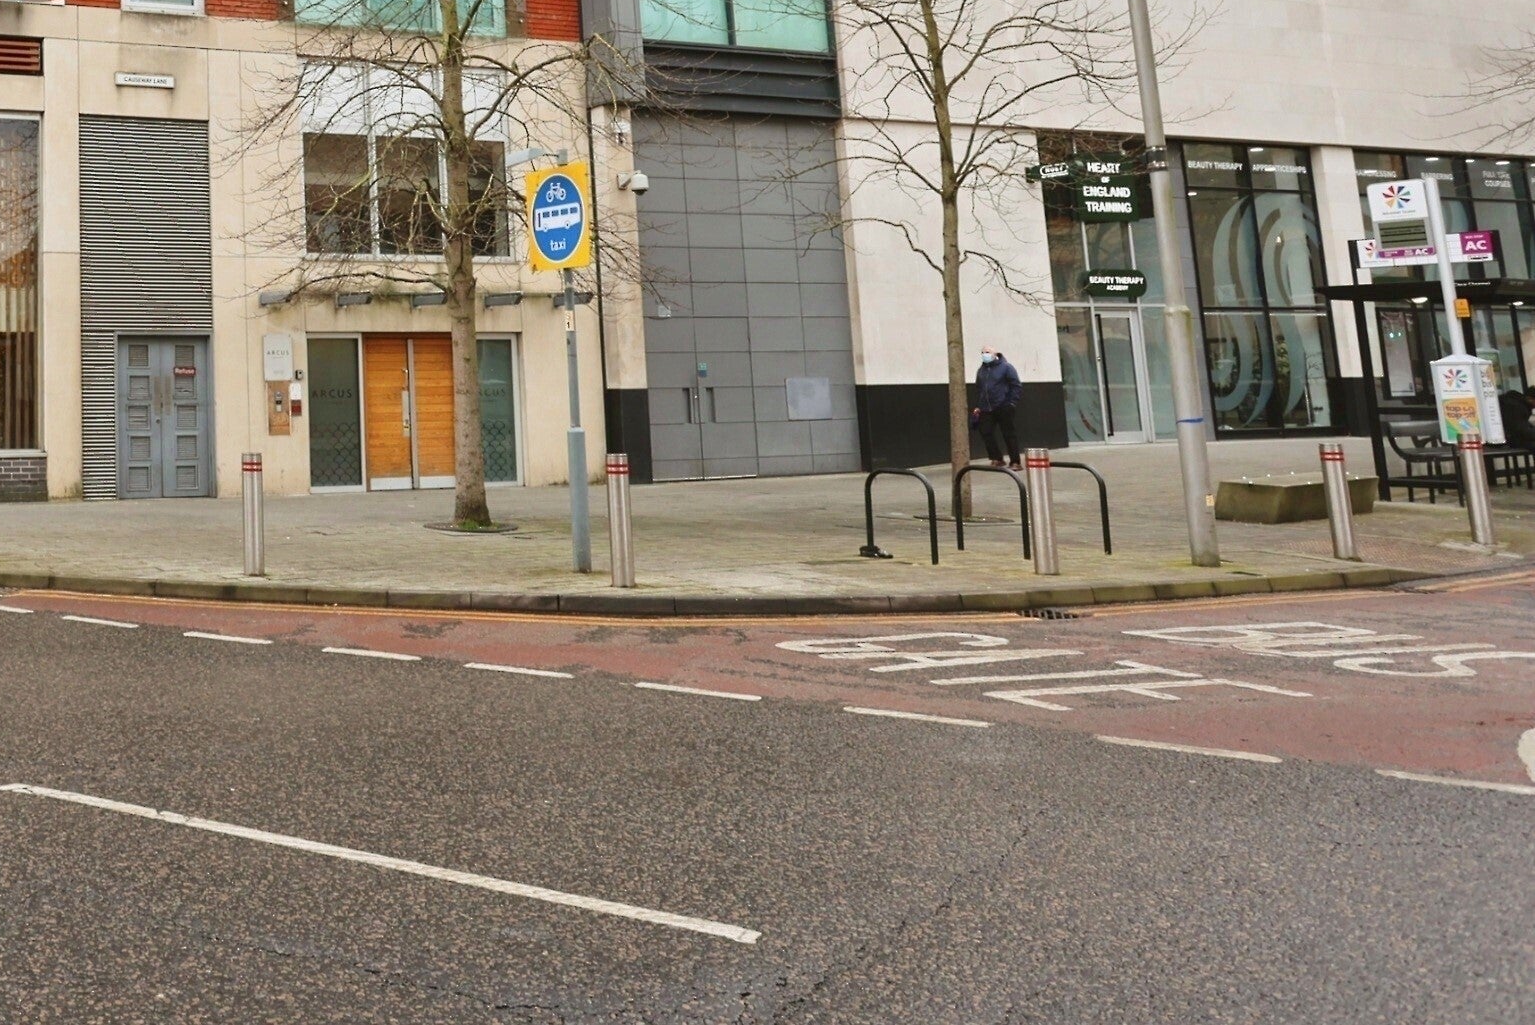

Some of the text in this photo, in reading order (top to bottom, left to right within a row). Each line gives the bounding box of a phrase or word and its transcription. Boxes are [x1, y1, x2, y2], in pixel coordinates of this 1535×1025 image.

[123, 76, 152, 84] CAUSEWAY
[1087, 162, 1121, 174] HEART
[1187, 160, 1243, 171] BEAUTY THERAPY
[1082, 186, 1131, 198] ENGLAND
[1085, 201, 1133, 213] TRAINING
[550, 238, 566, 251] taxi
[1465, 240, 1487, 251] AC
[1089, 276, 1144, 284] BEAUTY THERAPY
[174, 367, 195, 375] Refuse
[312, 388, 353, 400] ARCUS
[1121, 621, 1535, 677] BUS
[775, 632, 1315, 711] GATE
